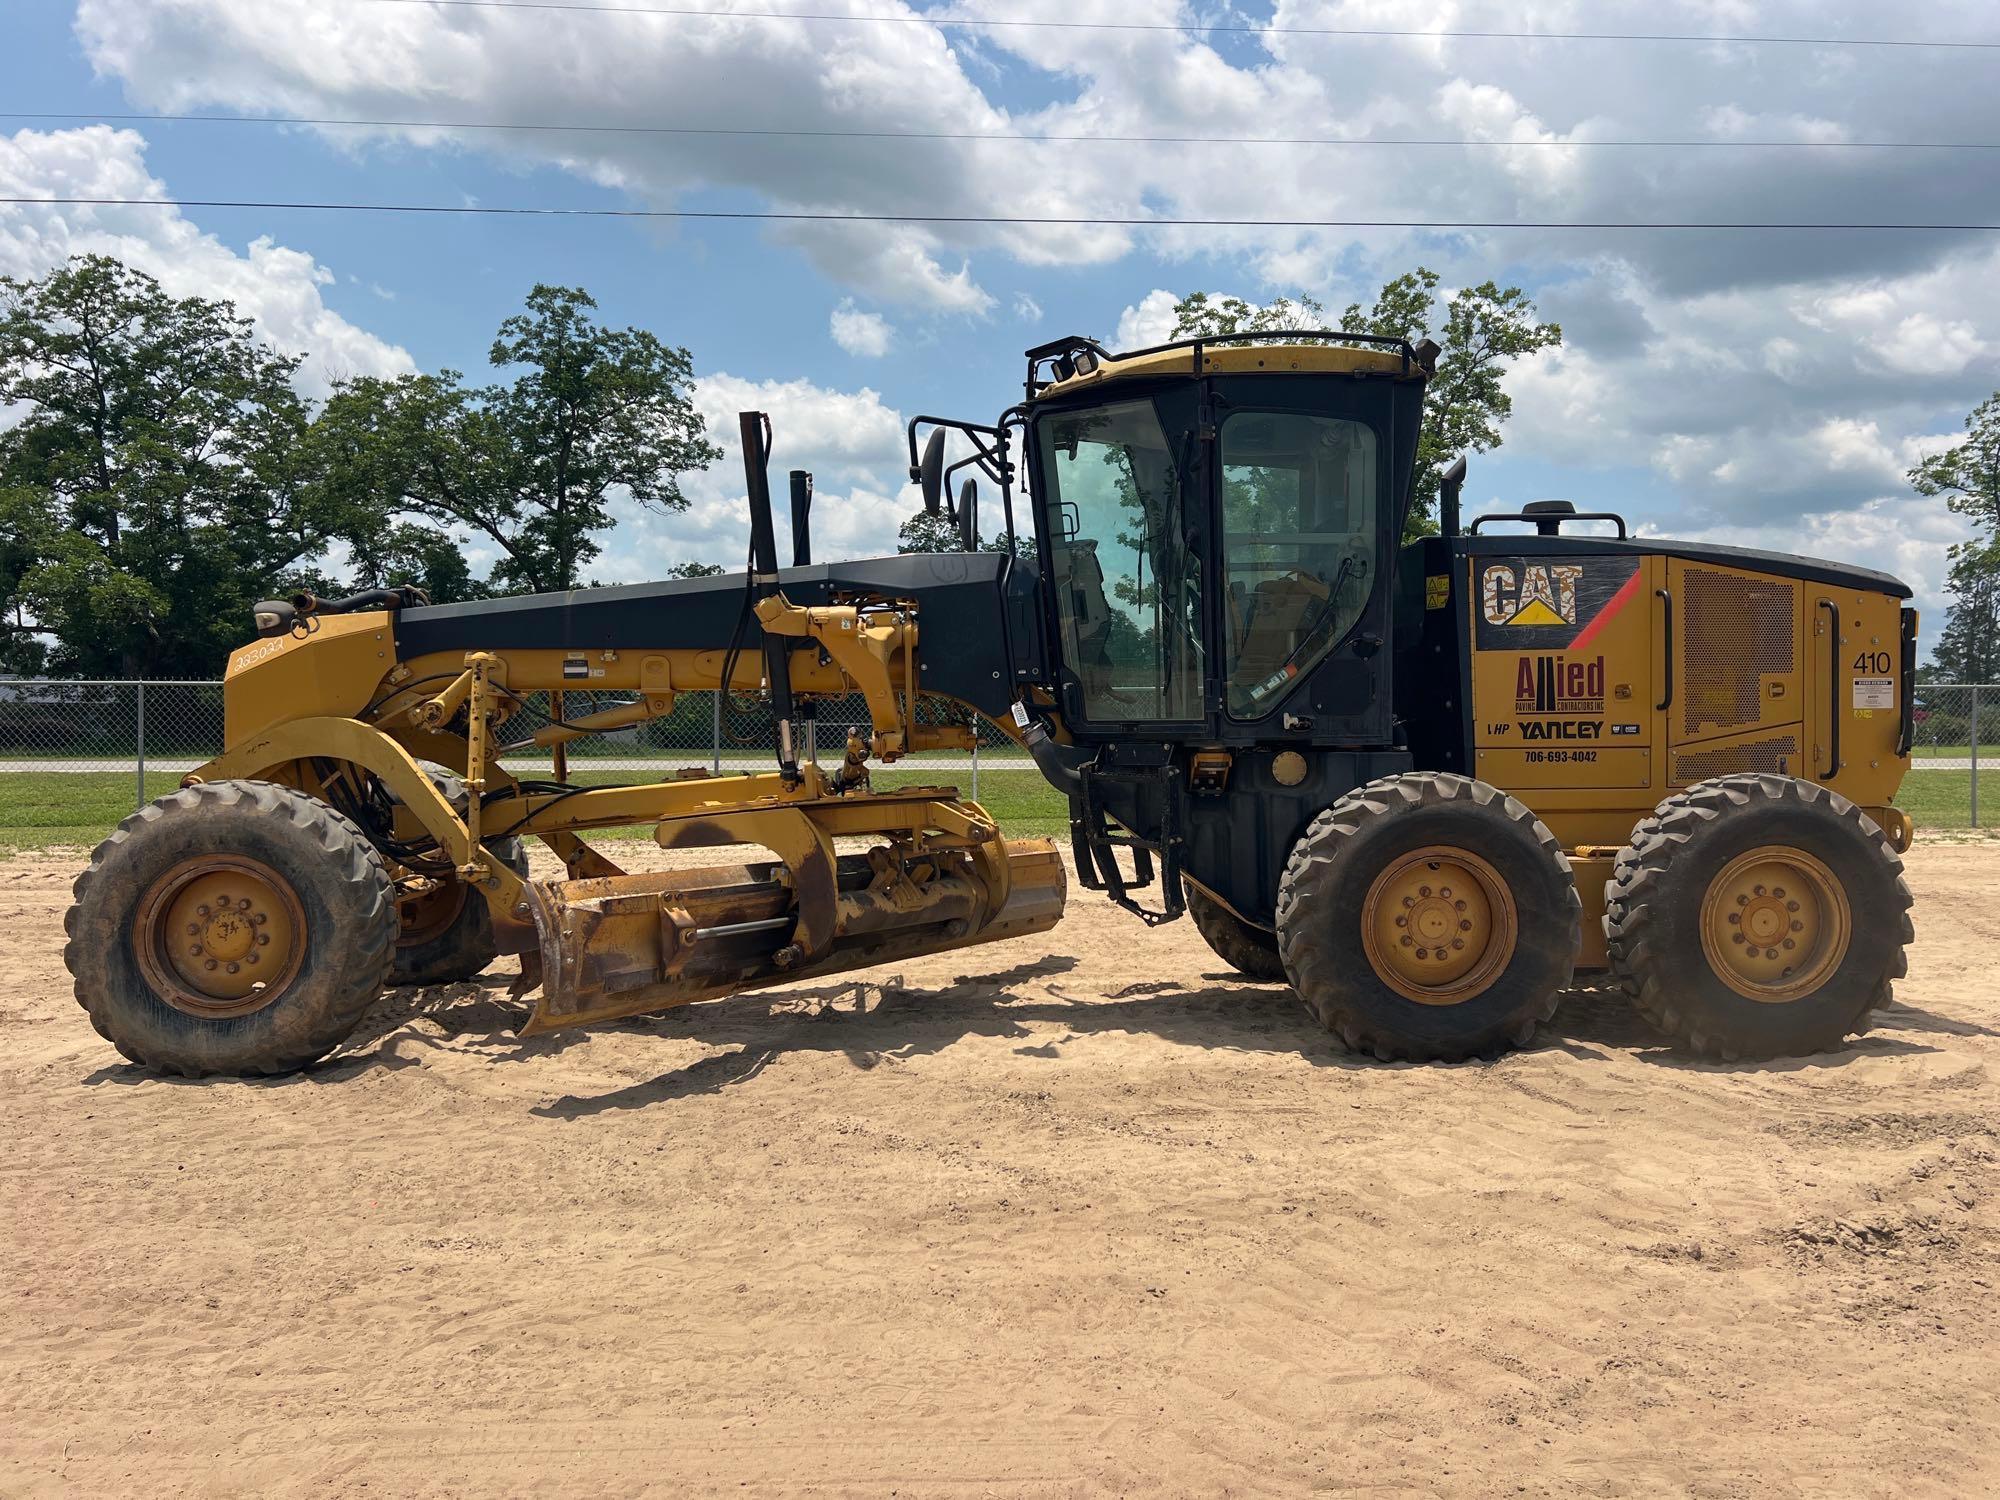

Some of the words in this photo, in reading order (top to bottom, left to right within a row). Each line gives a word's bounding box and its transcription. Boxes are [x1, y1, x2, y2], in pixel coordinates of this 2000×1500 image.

[1483, 565, 1583, 625] CAT
[1853, 652, 1891, 674] 410
[1516, 656, 1604, 711] Allied
[1516, 702, 1535, 711] PAVING
[1557, 701, 1593, 711] CONTRACTORS
[1595, 701, 1604, 710] INC
[1518, 721, 1604, 739] YANCEY
[1525, 751, 1597, 762] 706-693-4042
